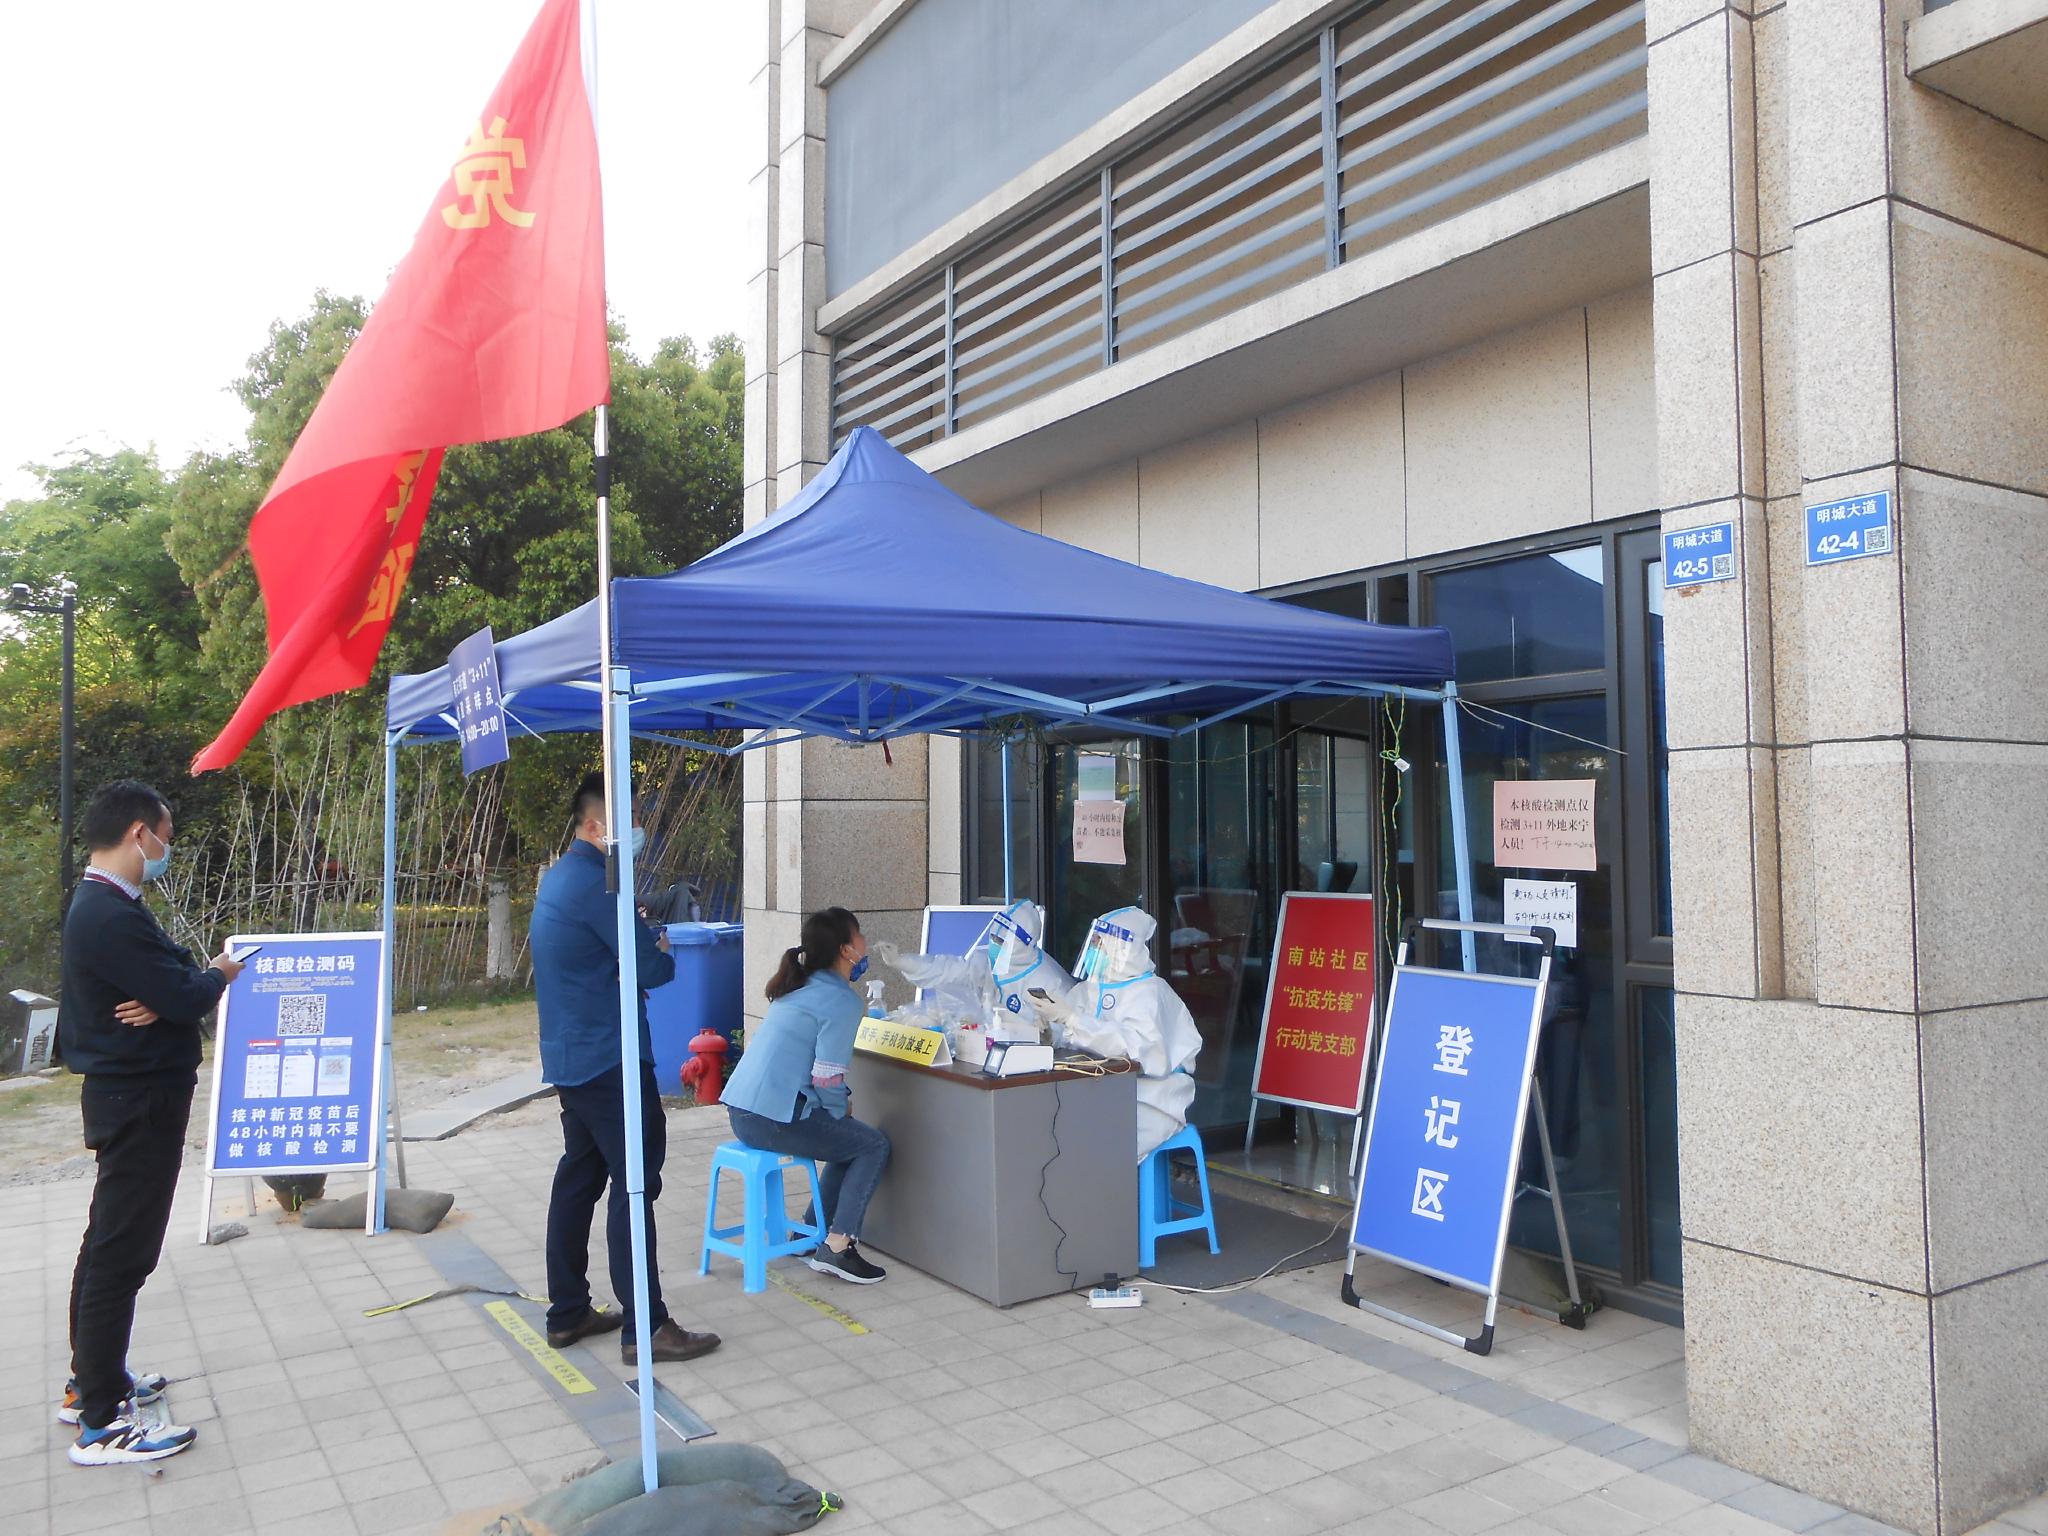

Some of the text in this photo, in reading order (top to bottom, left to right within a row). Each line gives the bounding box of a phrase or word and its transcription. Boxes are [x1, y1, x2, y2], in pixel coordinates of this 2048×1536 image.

[441, 115, 536, 229] 党
[1816, 499, 1877, 523] 明城大道
[1672, 529, 1723, 549] 明城大道
[1816, 530, 1859, 555] 42-4
[1673, 557, 1708, 579] 42-5
[255, 955, 356, 973] 核酸检测码
[1288, 946, 1369, 971] 南站社区
[1283, 985, 1363, 1013] “抗疫先锋”
[1275, 1027, 1357, 1057] 行动党支部
[231, 1105, 360, 1123] 接种新冠疫苗后
[1411, 1025, 1473, 1222] 登记区
[229, 1121, 359, 1139] 48小时内请不要
[229, 1139, 357, 1158] 做核酸检测
